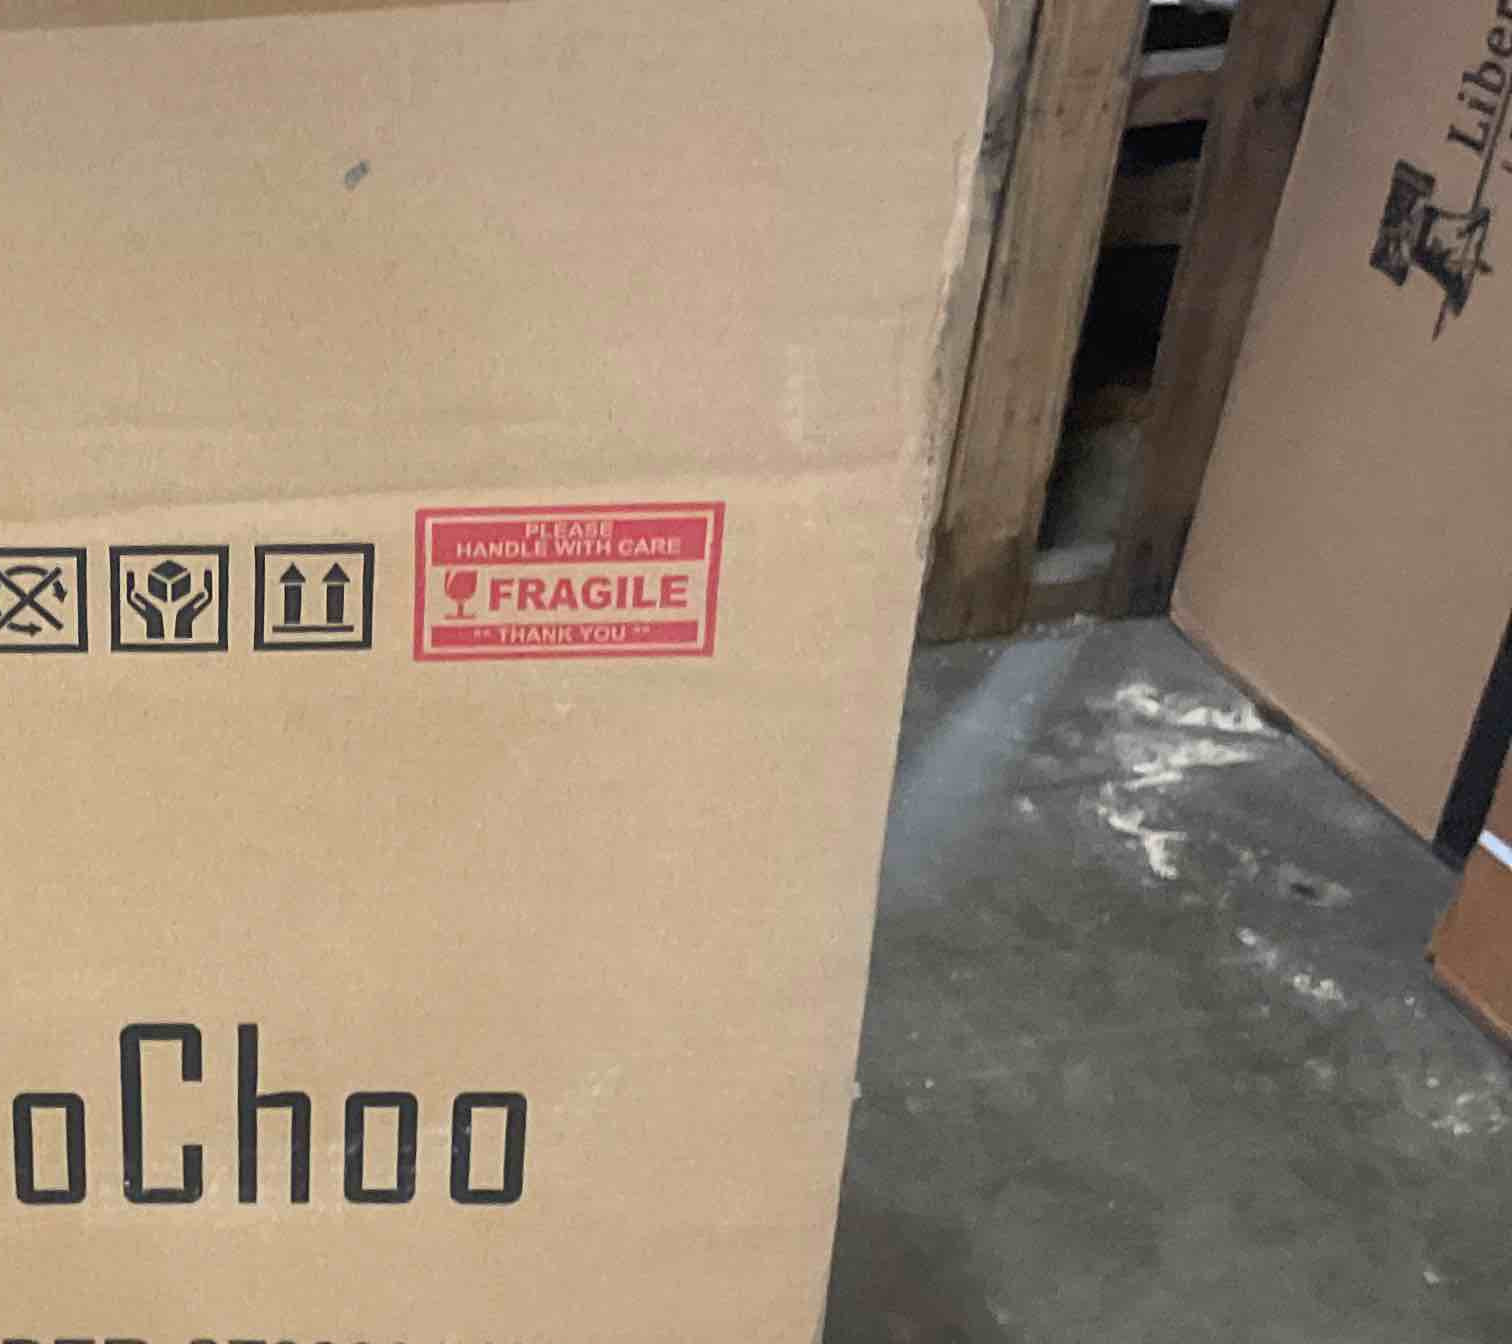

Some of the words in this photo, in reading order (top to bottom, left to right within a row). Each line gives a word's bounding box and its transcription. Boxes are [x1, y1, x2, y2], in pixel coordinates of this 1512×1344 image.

[525, 519, 614, 538] PLEASE
[455, 540, 548, 559] HANDLE
[554, 538, 612, 557] WITH
[618, 536, 682, 555] CARE
[488, 574, 690, 612] FRAGILE
[499, 626, 572, 645] THANK
[580, 624, 628, 643] YOU
